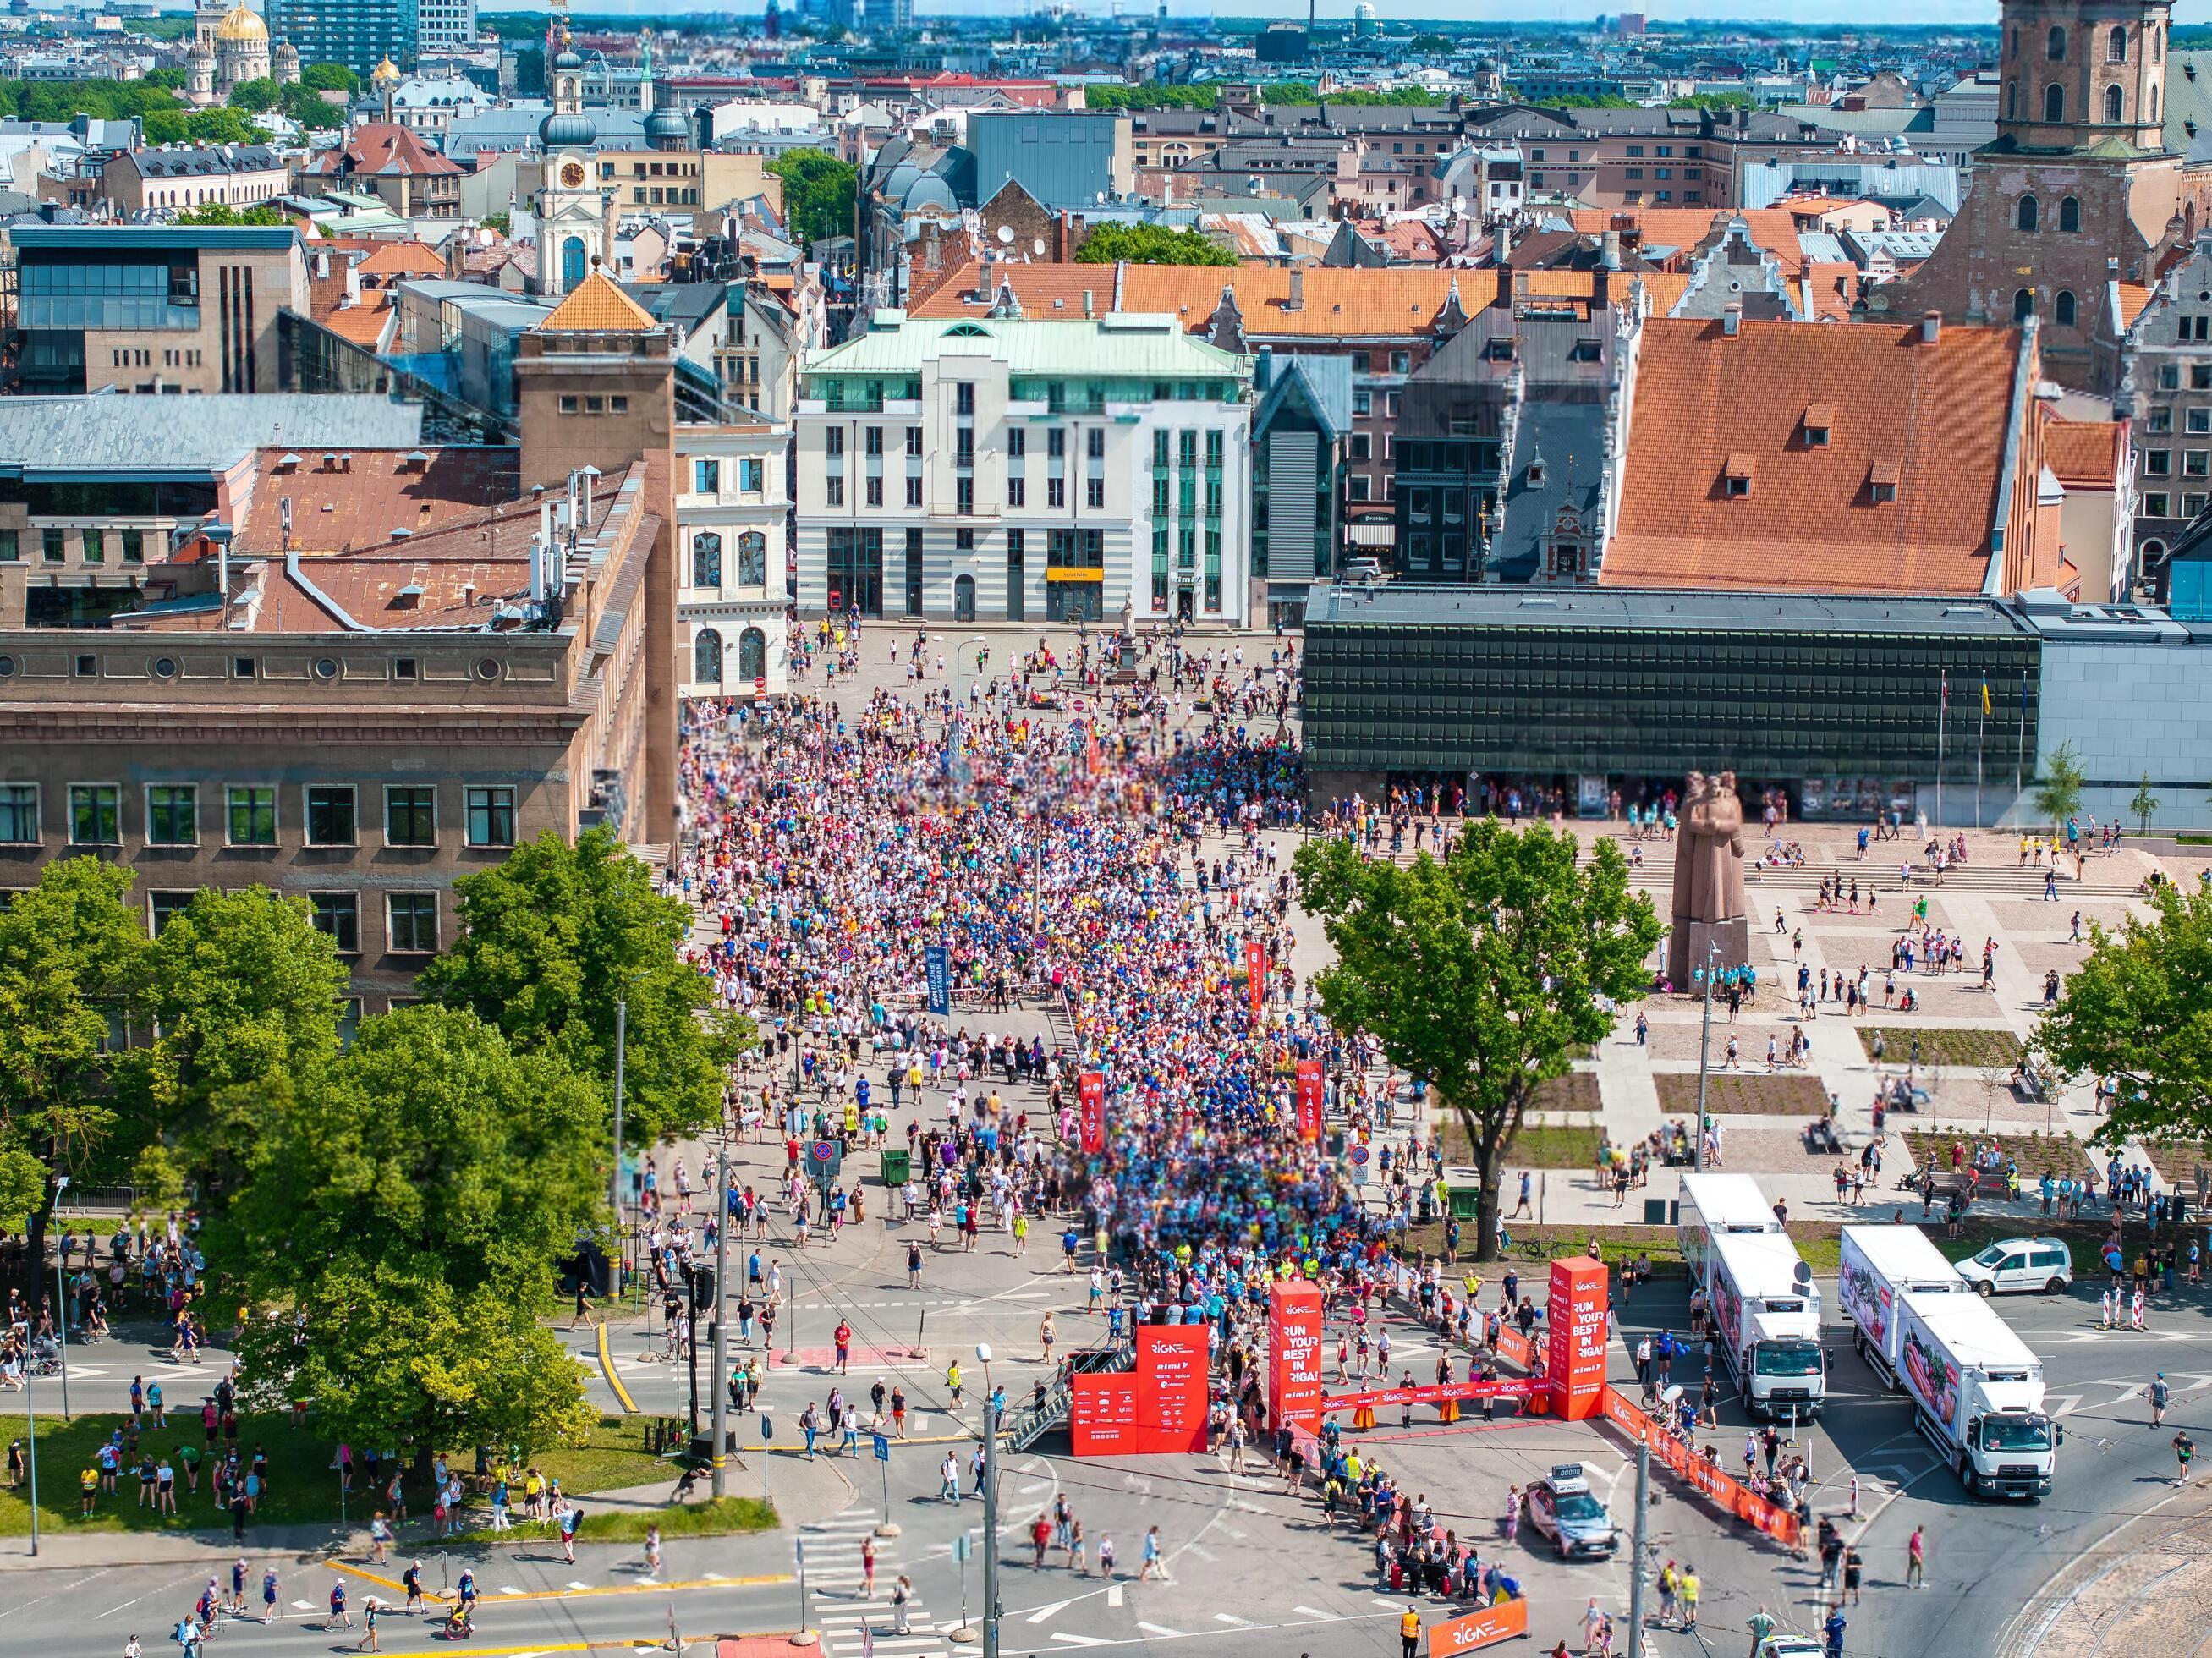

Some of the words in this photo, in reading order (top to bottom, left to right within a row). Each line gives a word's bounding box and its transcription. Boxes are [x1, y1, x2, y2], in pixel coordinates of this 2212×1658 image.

[1573, 1301, 1594, 1313] RUN
[1578, 1311, 1604, 1323] YOUR
[1283, 1326, 1306, 1337] RUN
[1573, 1323, 1599, 1337] BEST
[1289, 1336, 1319, 1348] YOUR
[1581, 1336, 1592, 1346] IN
[1282, 1348, 1312, 1361] BEST
[1578, 1345, 1604, 1358] RIGA!
[1293, 1360, 1305, 1371] IN
[1289, 1370, 1319, 1383] RIGA!
